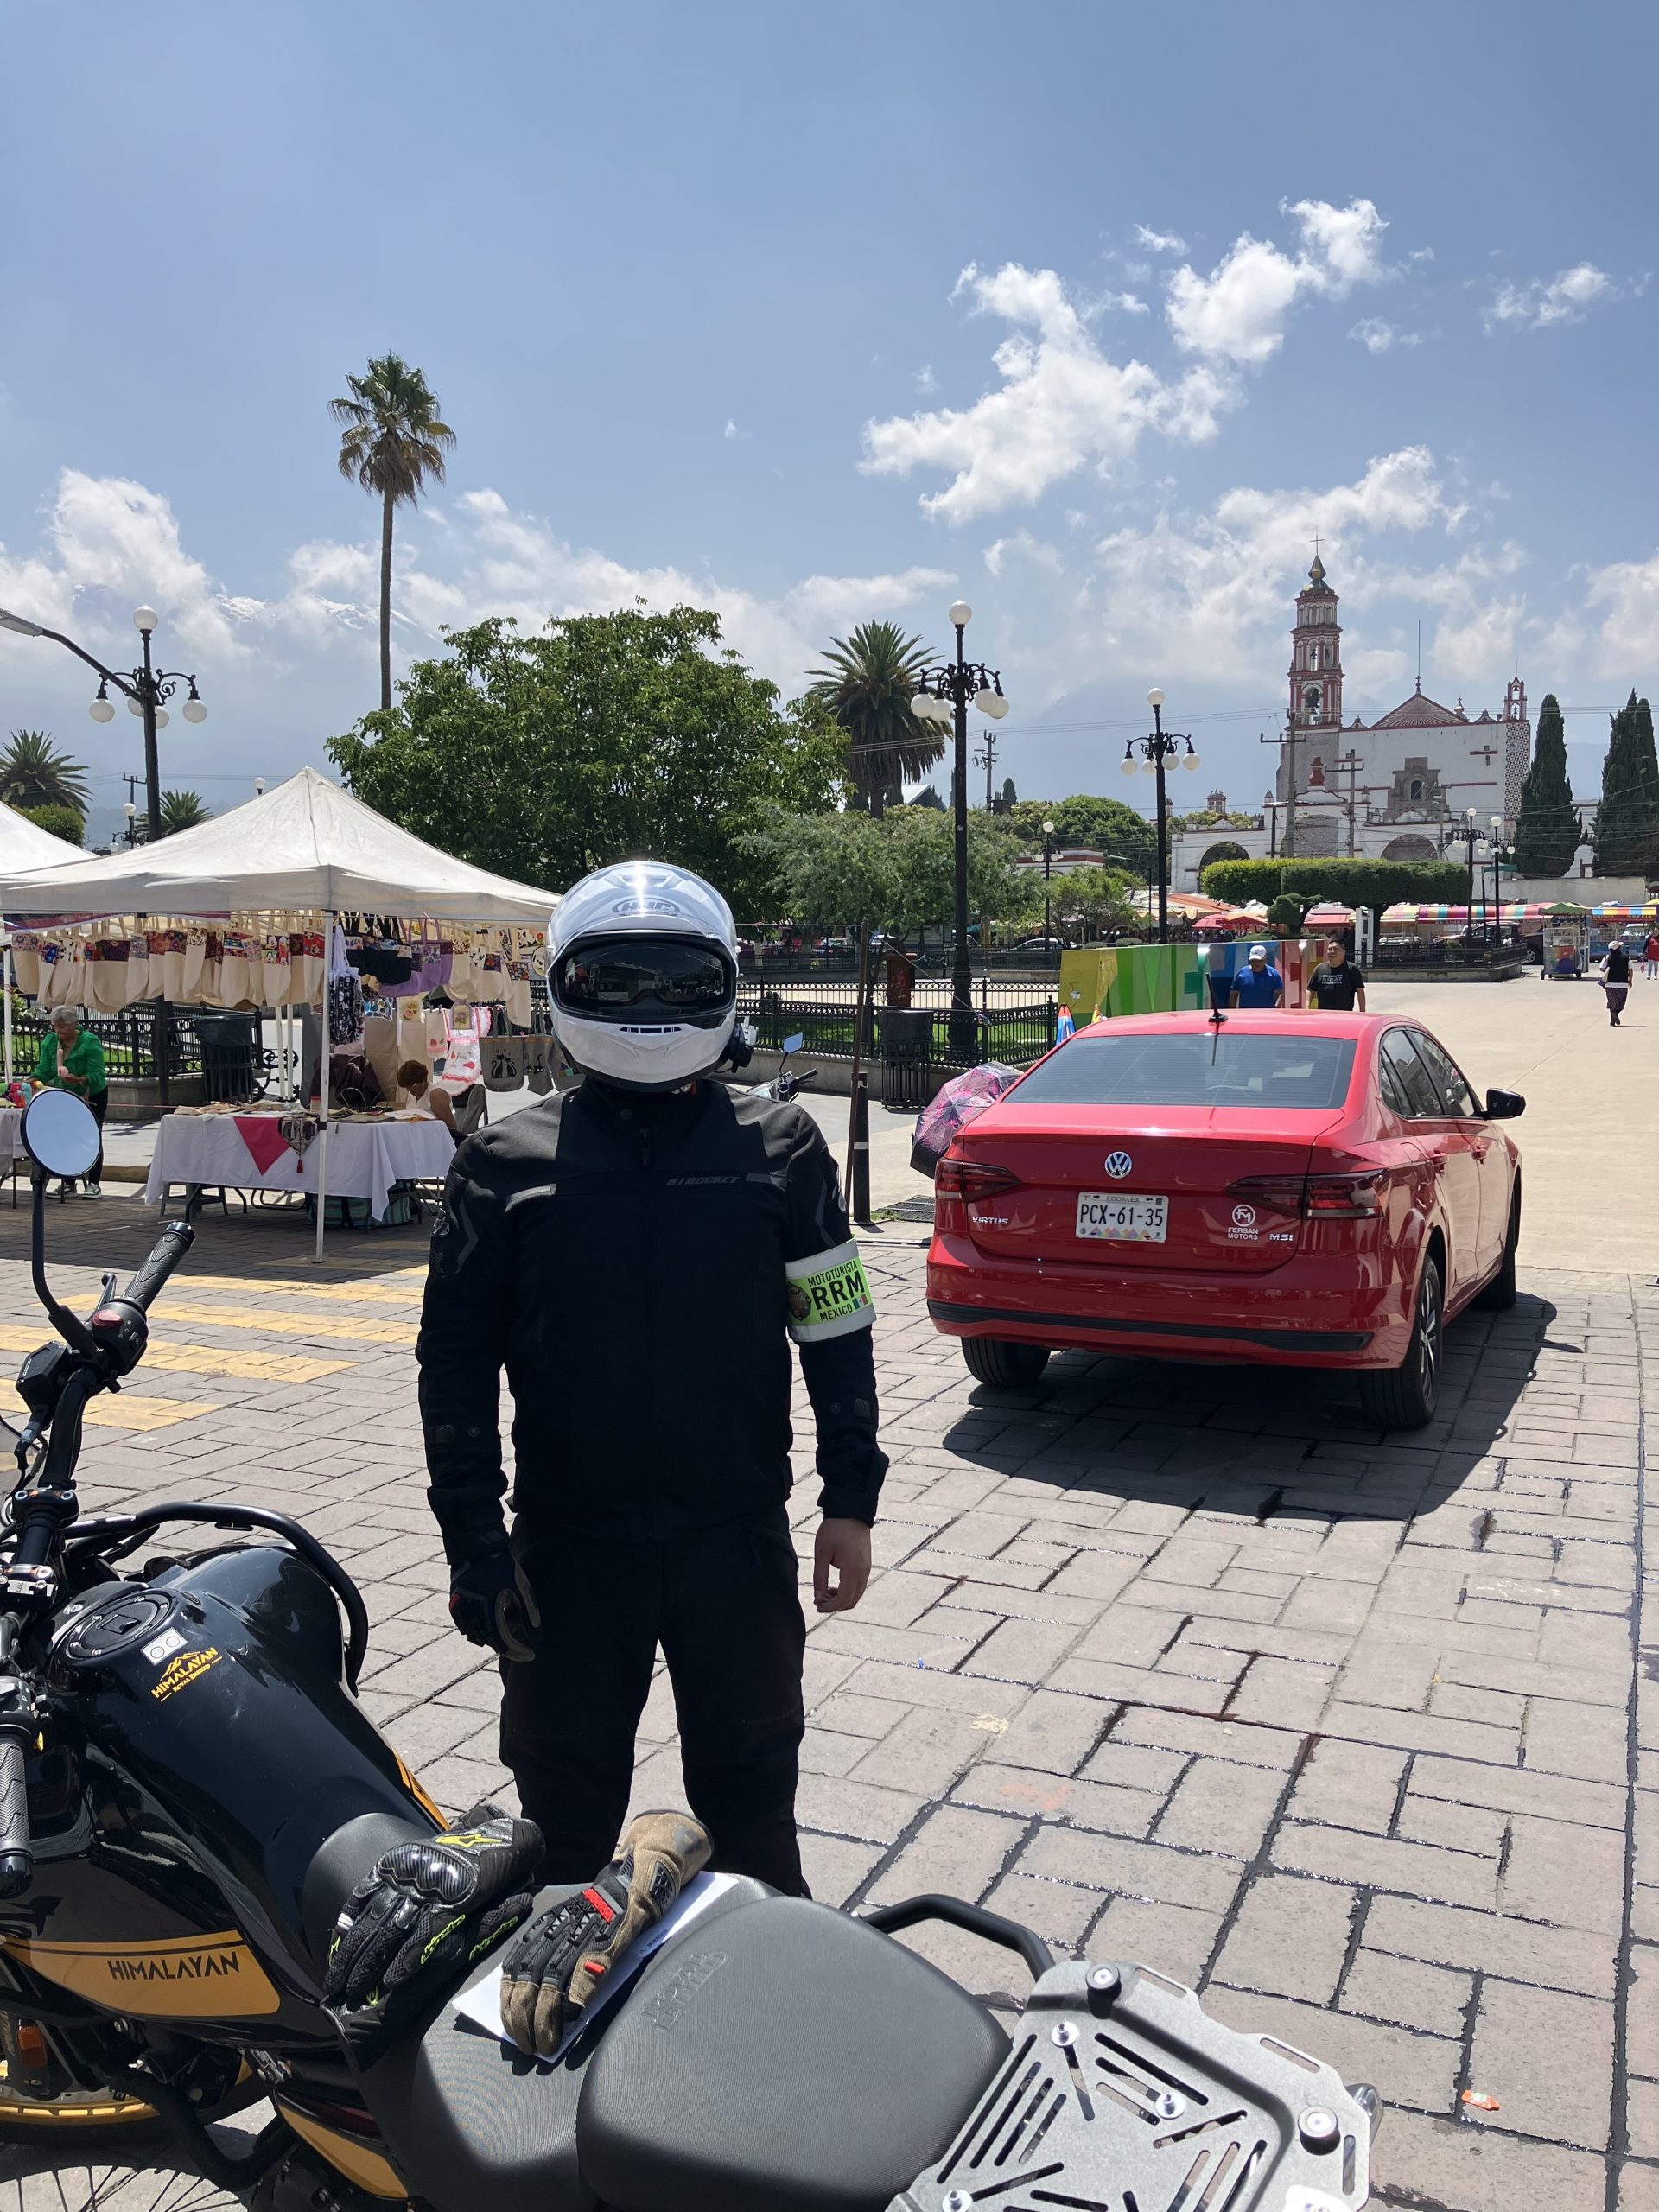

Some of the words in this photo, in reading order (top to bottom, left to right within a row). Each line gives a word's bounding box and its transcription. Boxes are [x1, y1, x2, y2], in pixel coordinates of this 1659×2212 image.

[972, 1216, 1009, 1224] VIRTUS
[1080, 1204, 1163, 1226] PCX-61-35
[807, 1260, 858, 1287] MOTOTURISTA
[810, 1270, 865, 1310] RRM
[819, 1303, 853, 1321] MÉXICO
[151, 1647, 219, 1699] HIMALAYAN
[107, 1951, 239, 1980] HIMALAYAN
